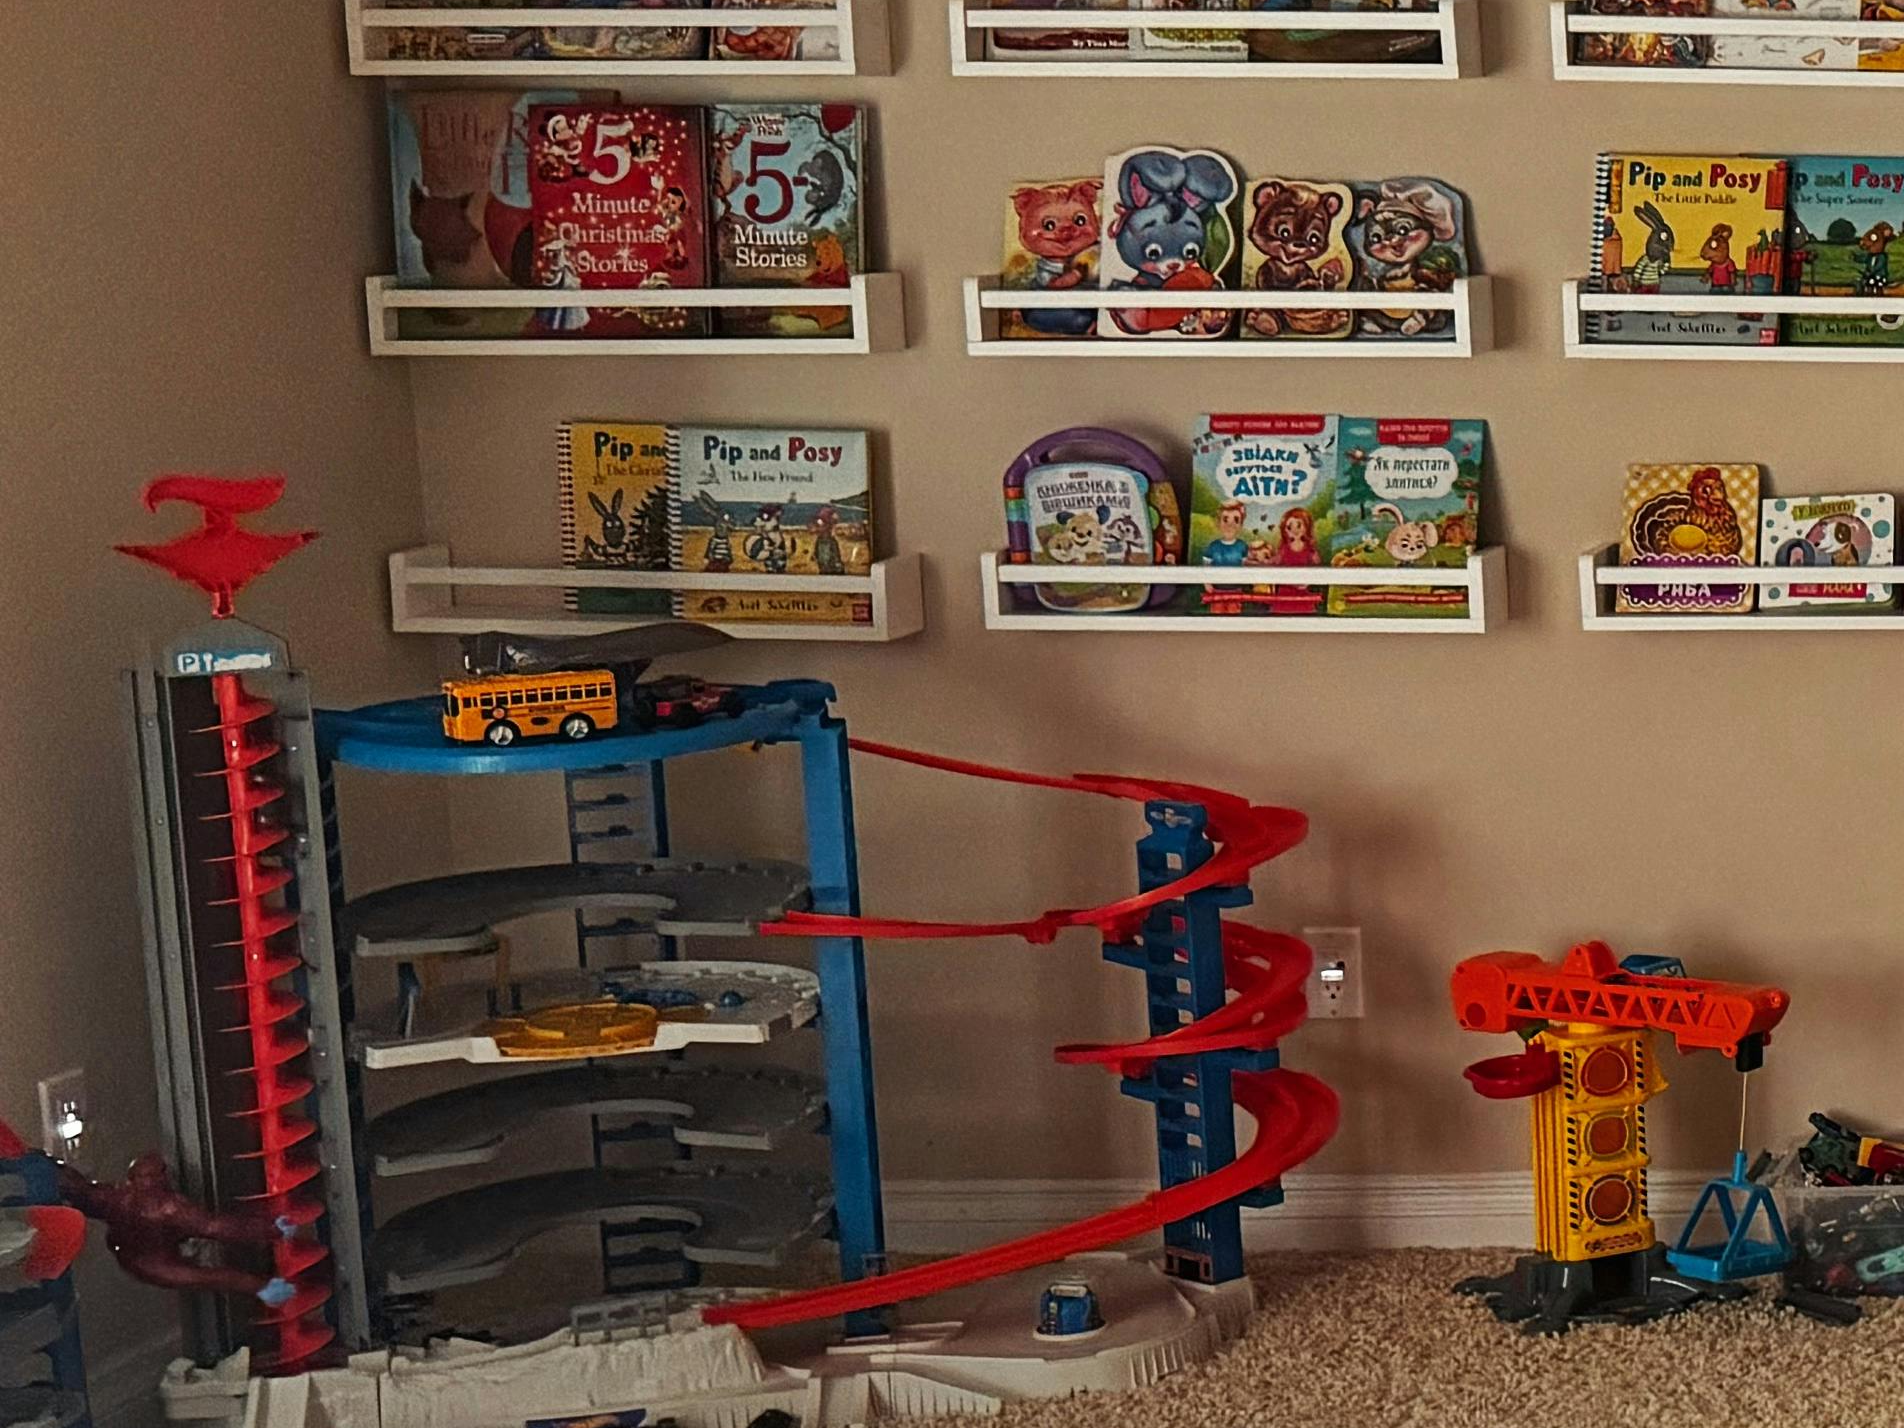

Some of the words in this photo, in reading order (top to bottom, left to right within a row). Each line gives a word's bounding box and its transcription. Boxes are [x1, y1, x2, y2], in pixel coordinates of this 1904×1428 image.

[589, 117, 635, 185] 5
[1629, 160, 1666, 191] Pip
[1672, 169, 1703, 188] and
[1709, 164, 1762, 193] Posy
[1814, 169, 1846, 188] and
[1851, 164, 1904, 194] Posy
[572, 191, 651, 216] Minute
[558, 222, 665, 244] Christmas
[734, 225, 808, 247] Minute
[576, 254, 649, 274] Stories
[735, 246, 807, 269] Stories
[593, 431, 634, 461] Pip
[703, 434, 744, 464] Pip
[749, 445, 781, 462] and
[787, 436, 844, 467] Posy
[1393, 458, 1450, 474] перестати
[1232, 471, 1308, 497] ДІТИ?
